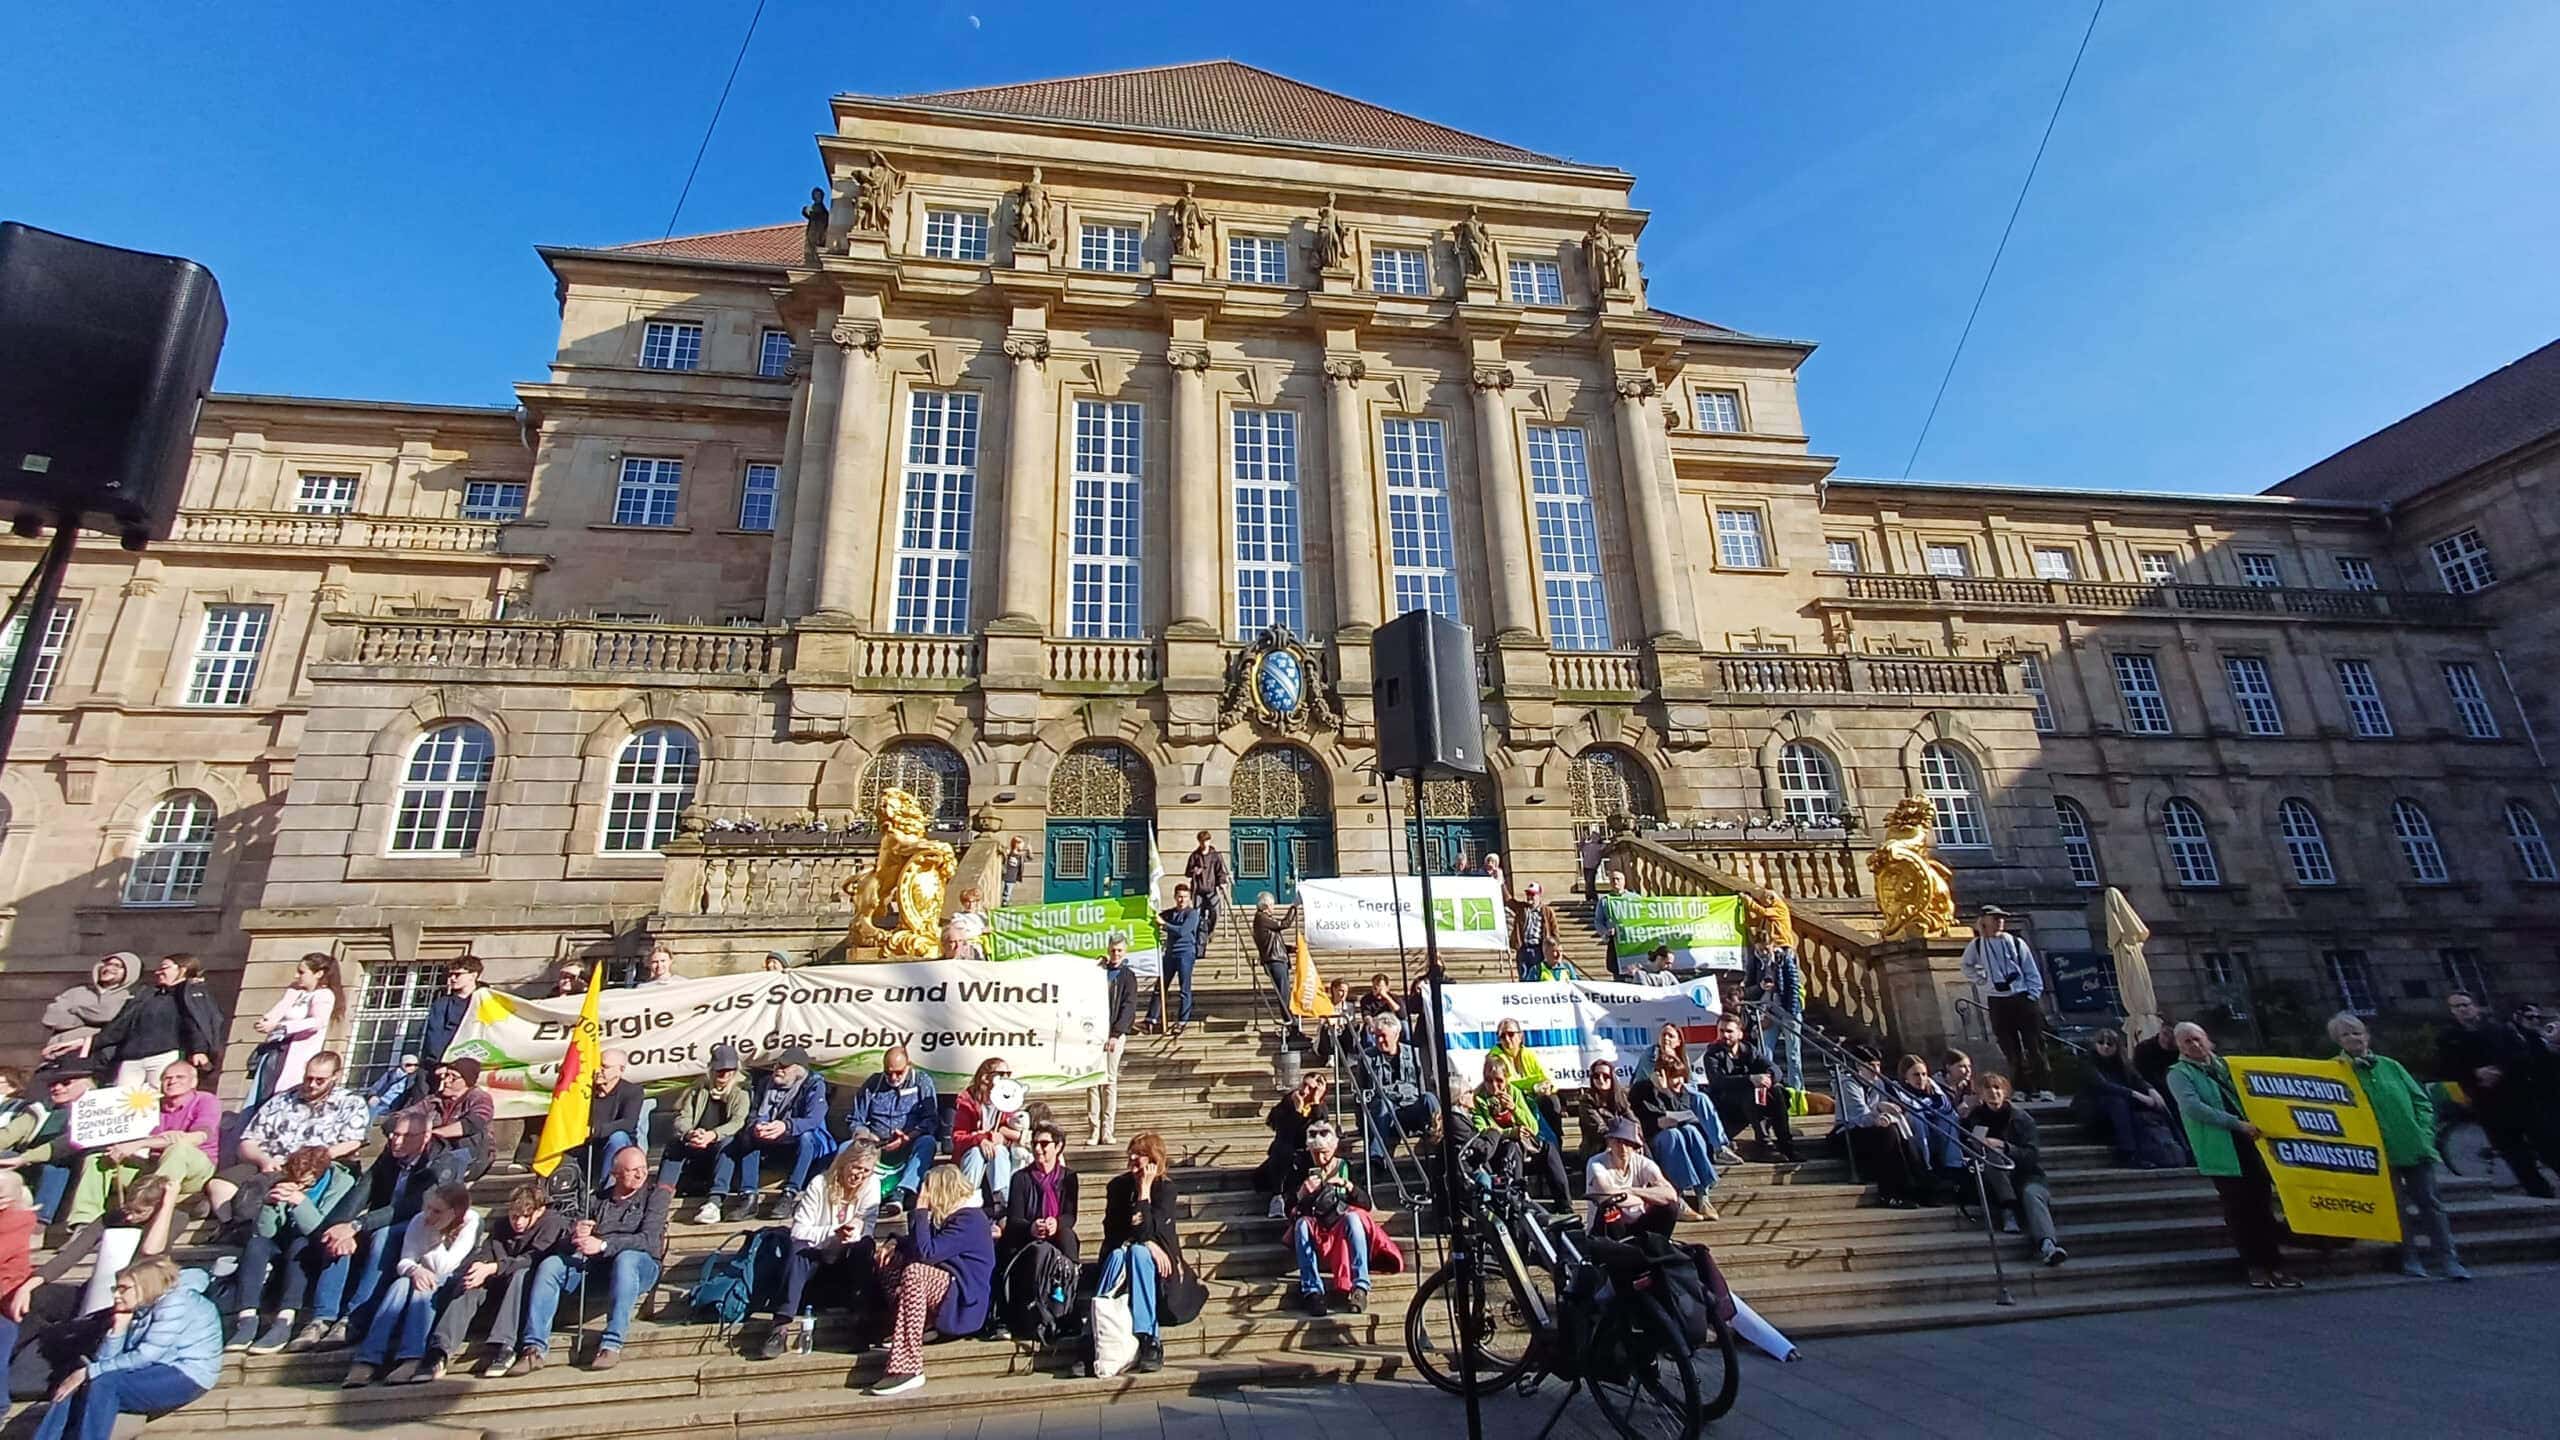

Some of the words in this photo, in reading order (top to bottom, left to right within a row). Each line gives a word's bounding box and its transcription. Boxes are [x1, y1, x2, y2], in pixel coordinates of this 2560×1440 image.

[994, 909, 1026, 932] Wir
[1031, 904, 1070, 929] sind
[1077, 902, 1105, 925] die
[1613, 898, 1644, 920] Wir
[1648, 899, 1683, 919] sind
[1688, 900, 1710, 918] die
[766, 983, 873, 1005] Sonne
[885, 982, 946, 1002] und
[957, 981, 1059, 1004] Wind!
[627, 1042, 698, 1066] onst
[763, 1027, 913, 1051] Gas-Lobby
[921, 1027, 1043, 1054] gewinnt.
[2249, 1075, 2350, 1102] KLIMASCHUTZ
[78, 1098, 97, 1109] DIE
[78, 1106, 113, 1120] SONNE
[77, 1130, 94, 1141] DIE
[98, 1124, 129, 1137] LAGE
[2277, 1142, 2377, 1169] GASAUSSTIEG
